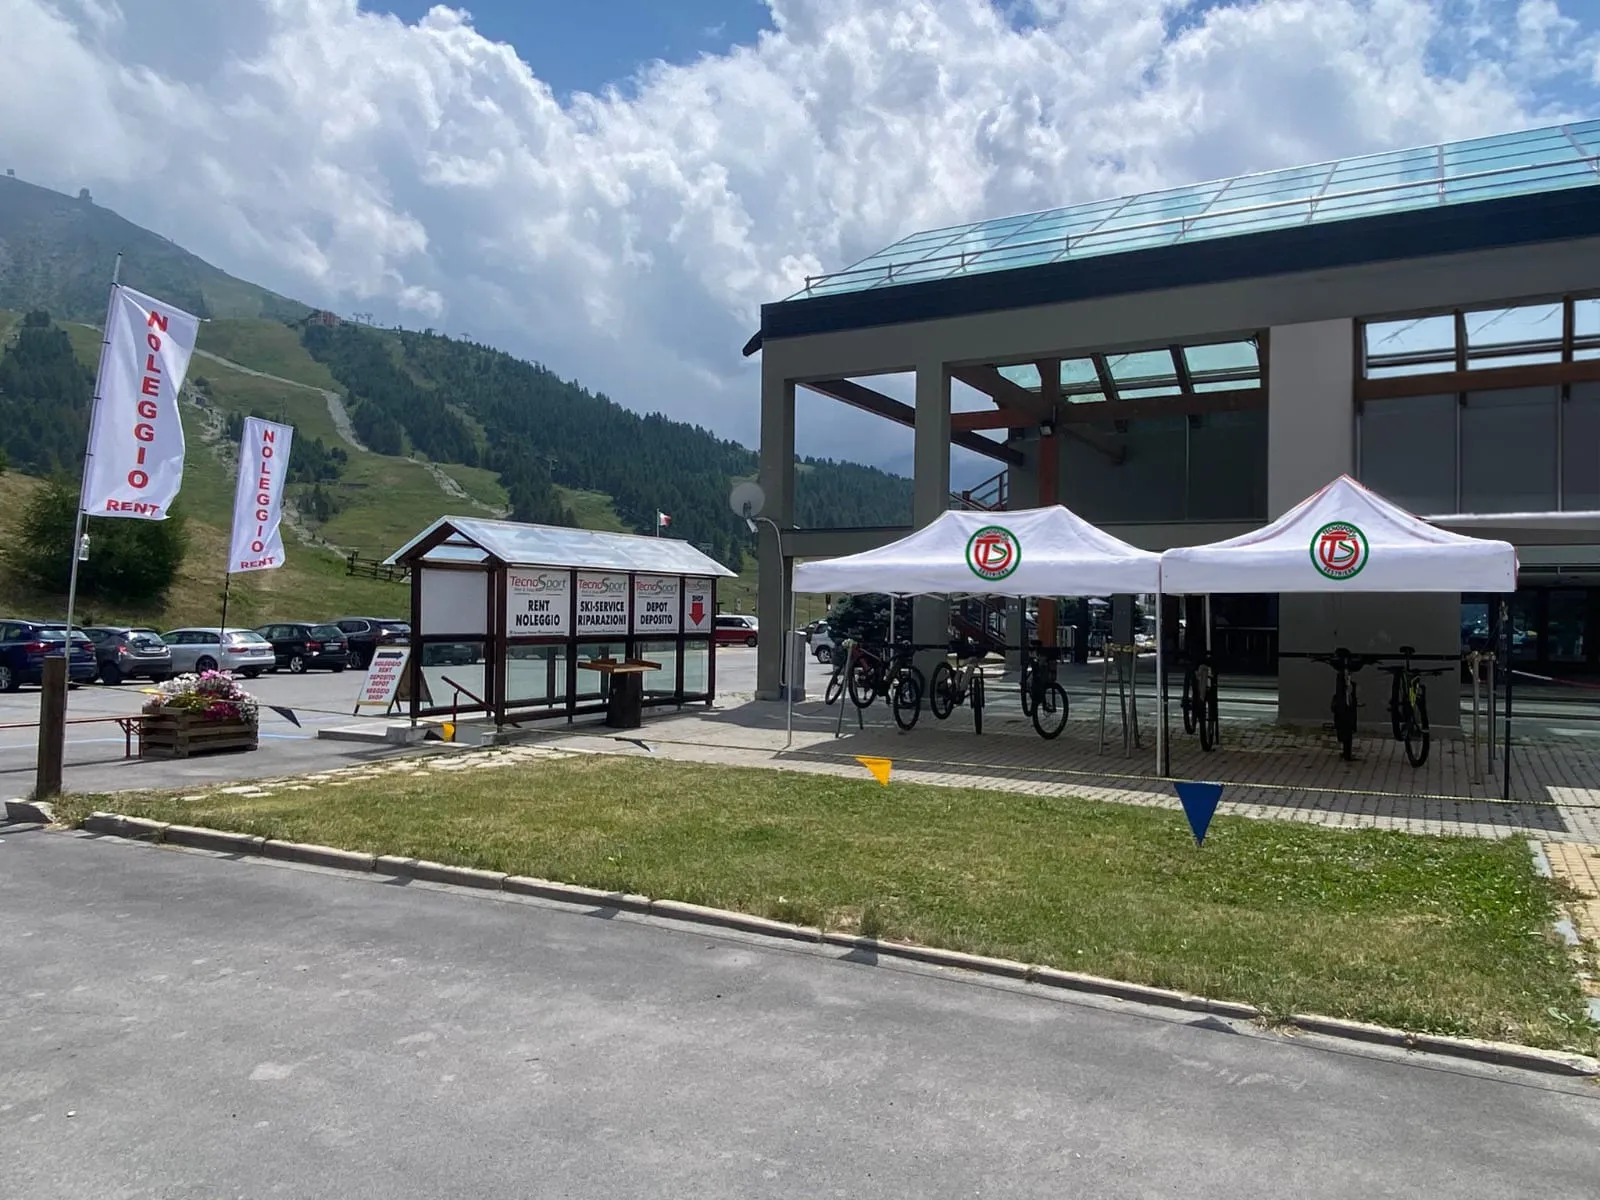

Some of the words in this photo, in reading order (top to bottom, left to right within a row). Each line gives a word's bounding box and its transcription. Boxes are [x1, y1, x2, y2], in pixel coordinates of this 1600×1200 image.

[127, 310, 168, 489] NOLEGGIO
[250, 429, 275, 553] NOLEGGIO
[106, 499, 160, 516] RENT
[240, 556, 275, 569] RENT
[510, 573, 566, 592] TecnoSport
[578, 576, 627, 595] TecnoSport
[636, 579, 678, 595] TecnoSport
[528, 600, 550, 612] RENT
[580, 601, 624, 612] SKI-SERVICE
[646, 602, 668, 612] DEPOT
[515, 614, 561, 626] NOLEGGIO
[577, 614, 627, 626] RIPARAZIONI
[640, 614, 673, 625] DEPOSITO
